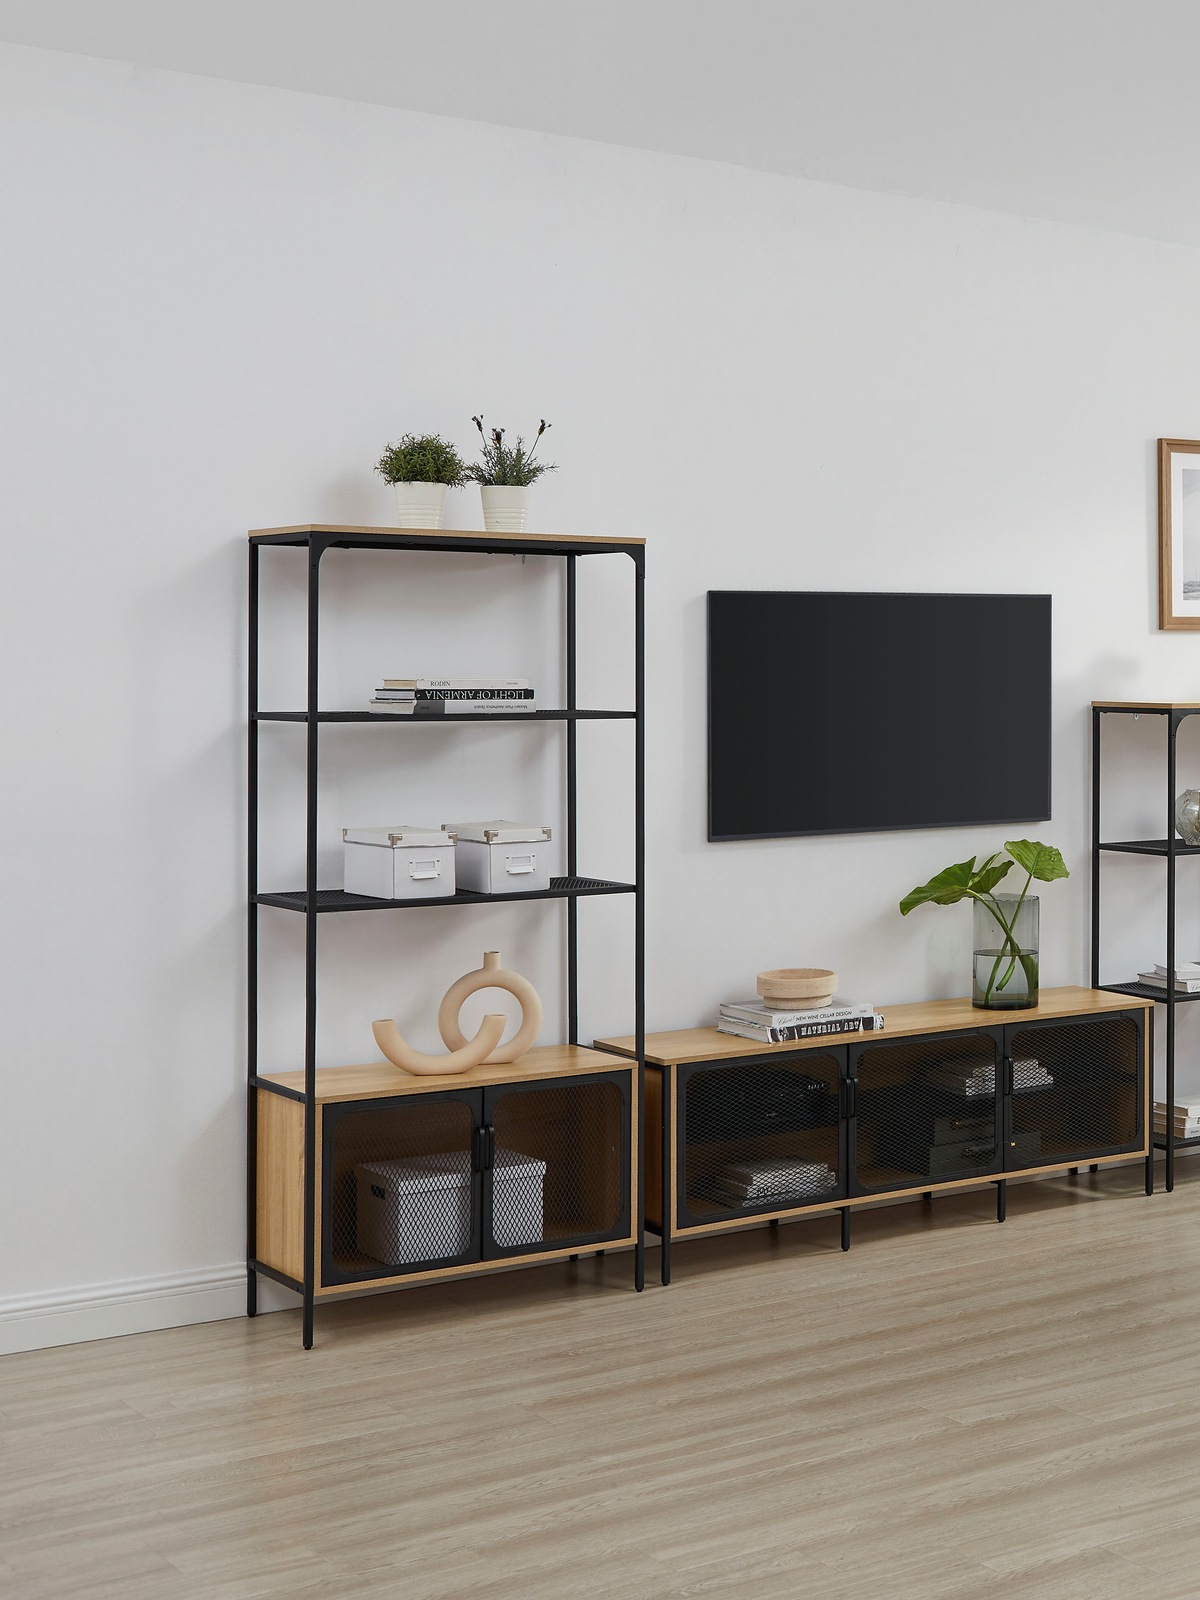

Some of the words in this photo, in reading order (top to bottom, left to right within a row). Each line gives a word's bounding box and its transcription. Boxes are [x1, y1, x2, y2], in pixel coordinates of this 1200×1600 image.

[425, 690, 475, 700] ARMENIA
[476, 690, 491, 700] OF
[492, 690, 525, 700] LIGHT
[801, 1023, 841, 1035] MATERIAL
[844, 1021, 860, 1031] ART
